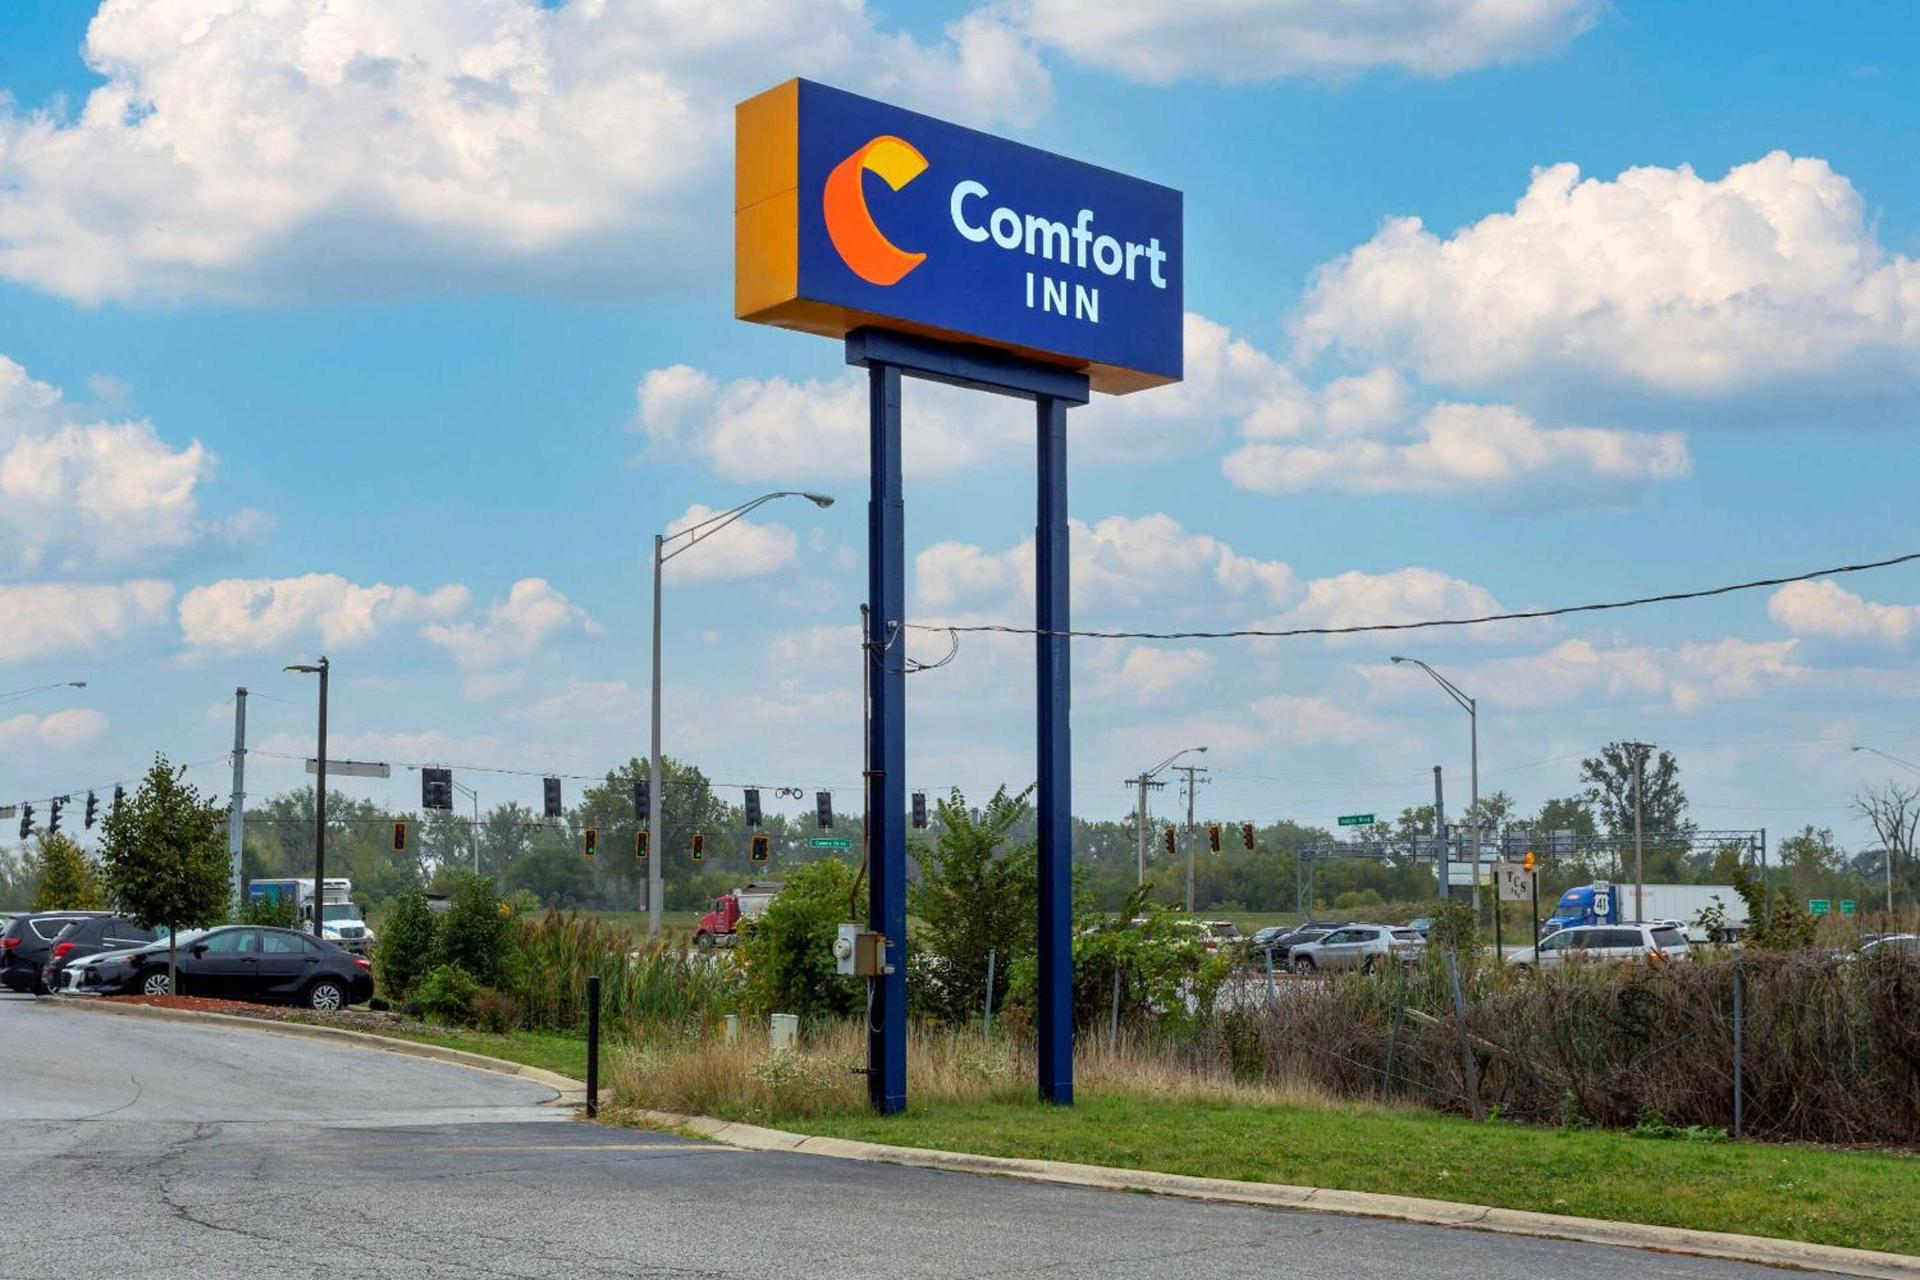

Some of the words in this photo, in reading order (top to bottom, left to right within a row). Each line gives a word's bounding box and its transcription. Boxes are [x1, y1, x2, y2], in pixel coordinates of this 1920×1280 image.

[951, 180, 1167, 289] Comfort
[1026, 272, 1099, 323] INN
[1596, 898, 1606, 911] 41
